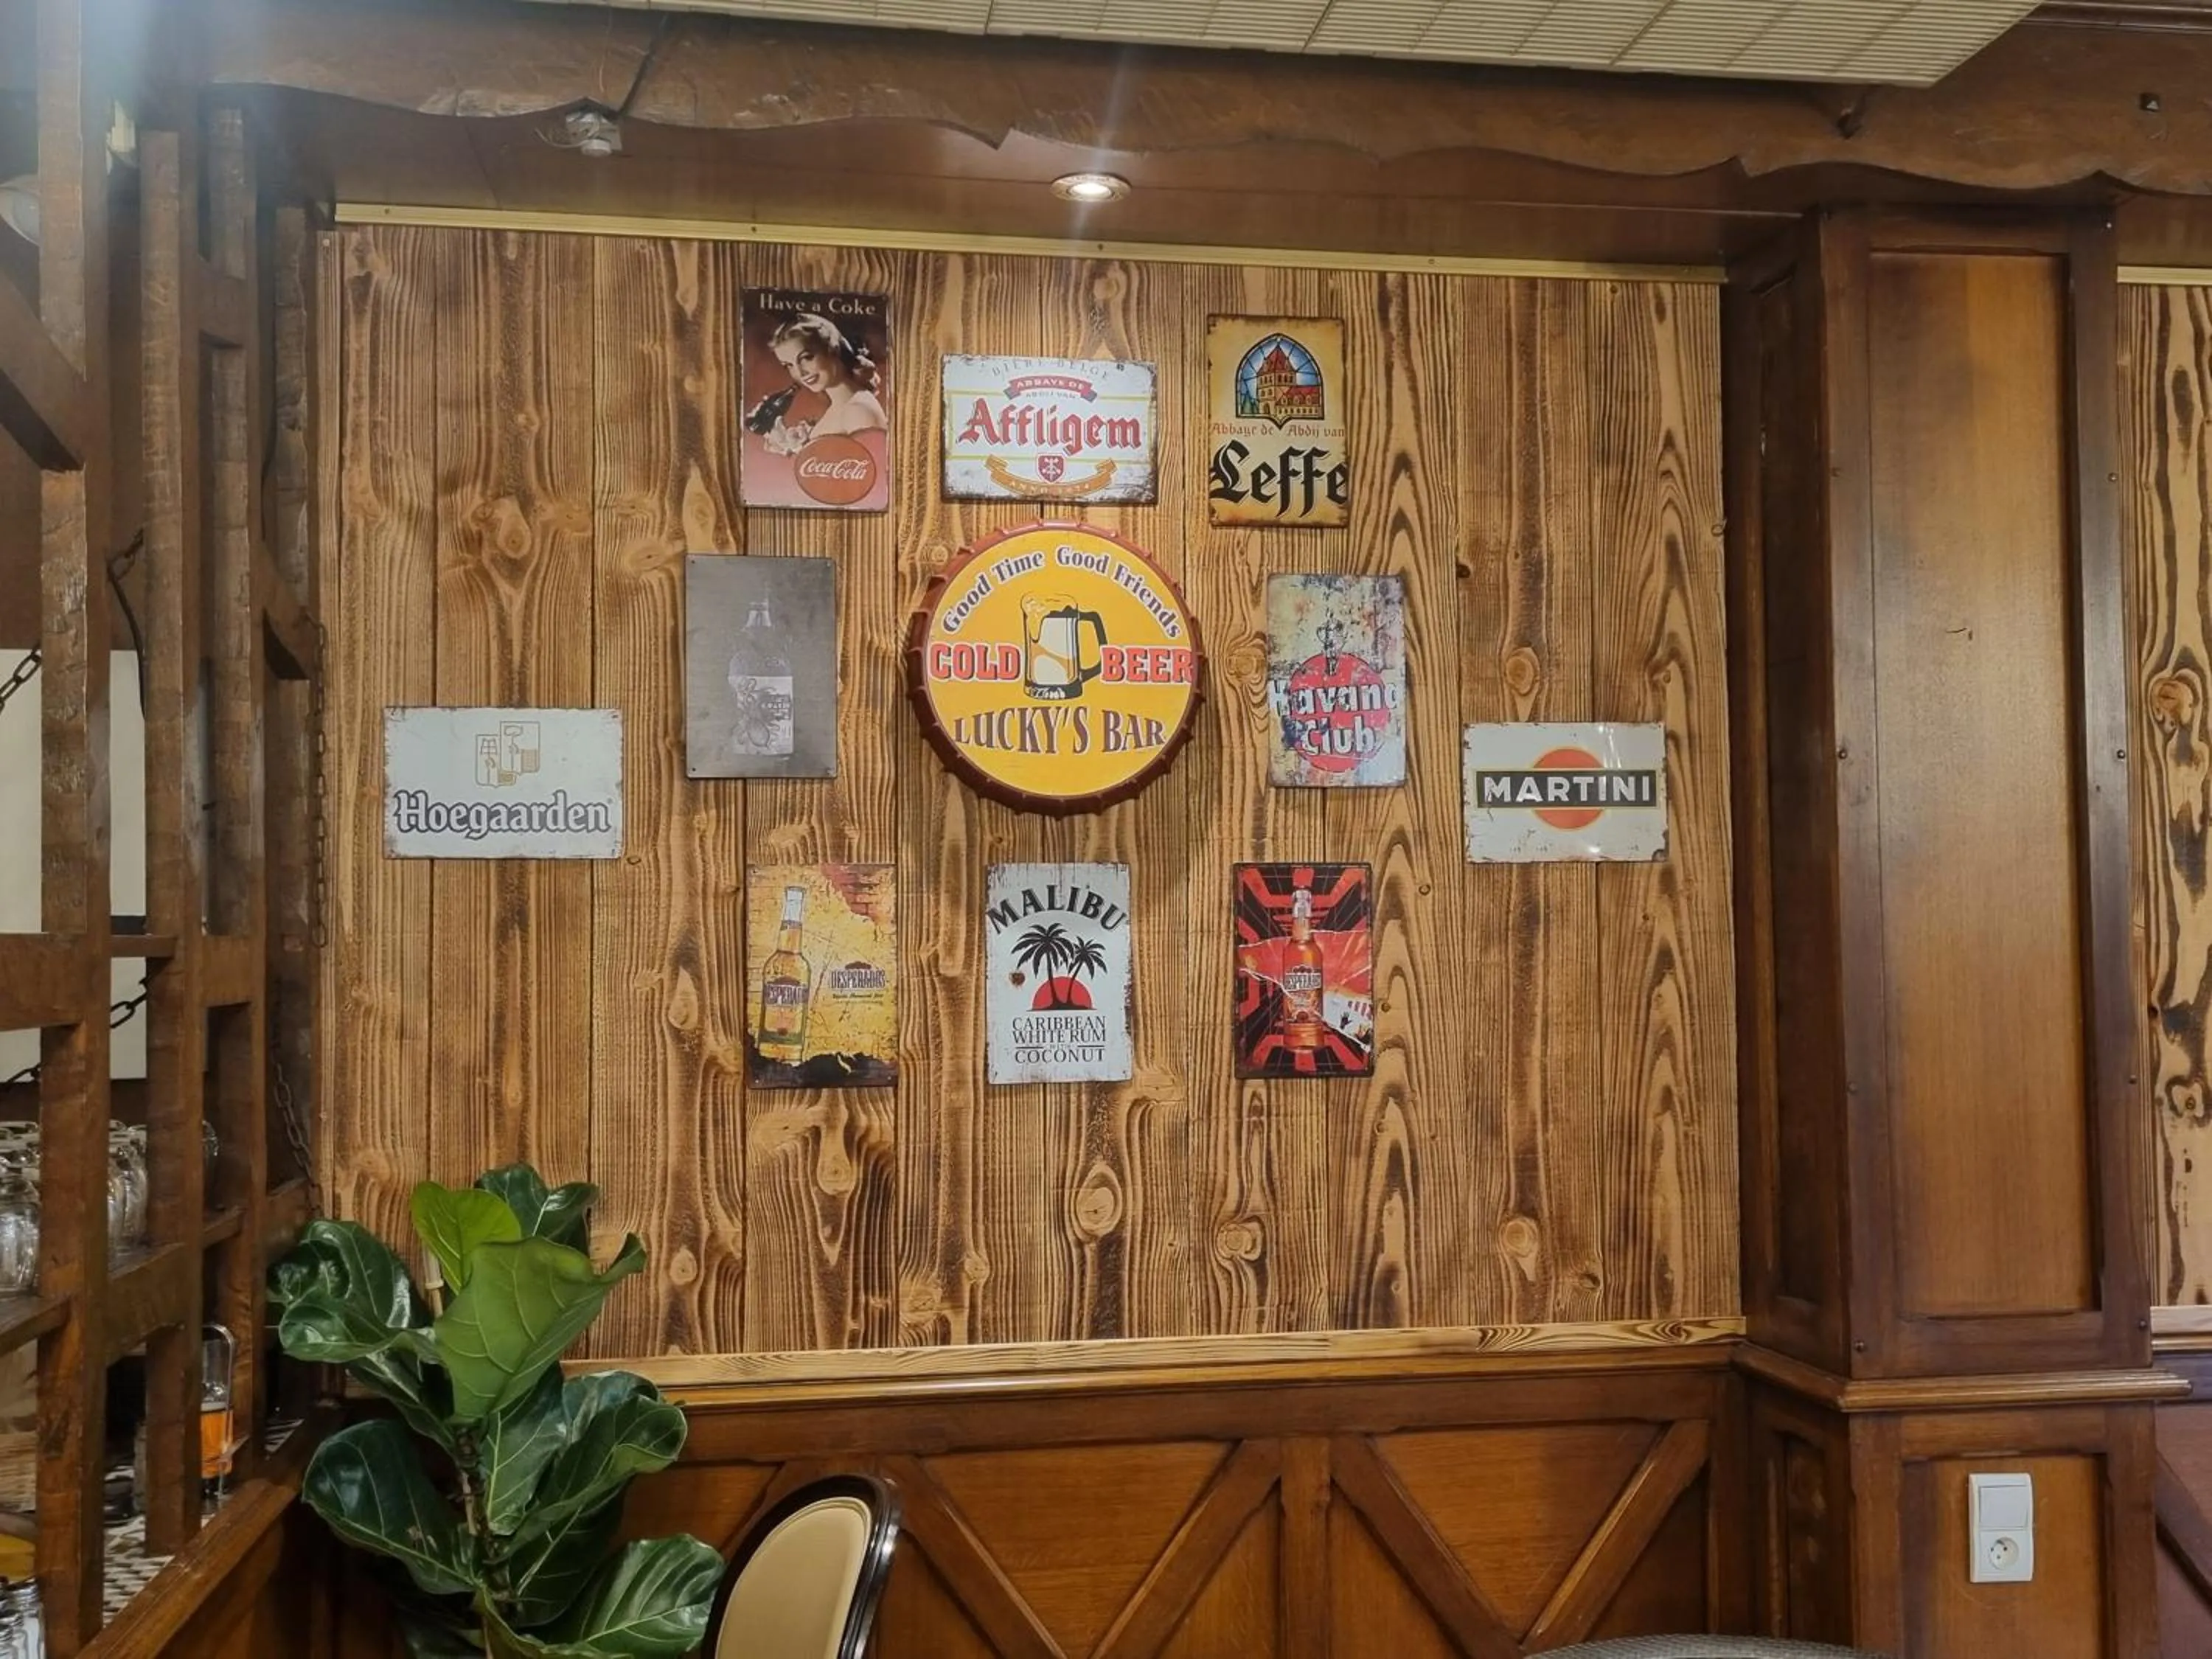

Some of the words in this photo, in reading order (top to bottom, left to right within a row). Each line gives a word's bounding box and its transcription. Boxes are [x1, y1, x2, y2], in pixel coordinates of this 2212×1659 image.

[759, 293, 806, 311] Have
[812, 302, 821, 313] a
[828, 297, 876, 316] Coke
[956, 397, 1142, 456] Affligem
[1209, 439, 1347, 517] Leffe
[942, 574, 992, 635] Good
[991, 549, 1045, 581] Time
[1056, 546, 1110, 574] Good
[1113, 563, 1181, 639] Friends
[929, 643, 1021, 681] COLD
[1101, 646, 1193, 683] BEER
[954, 706, 1088, 754] LUCKY'S
[1102, 710, 1166, 754] BAR
[1300, 715, 1377, 756] Club
[1483, 775, 1651, 803] MARTINI
[393, 789, 612, 841] Hoegaarden
[987, 884, 1127, 935] MALIBU
[1012, 1015, 1106, 1031] CARIBBEAN
[1012, 1030, 1065, 1044] WHITE
[1069, 1029, 1106, 1043] RUM
[1015, 1048, 1105, 1064] COCONUT
